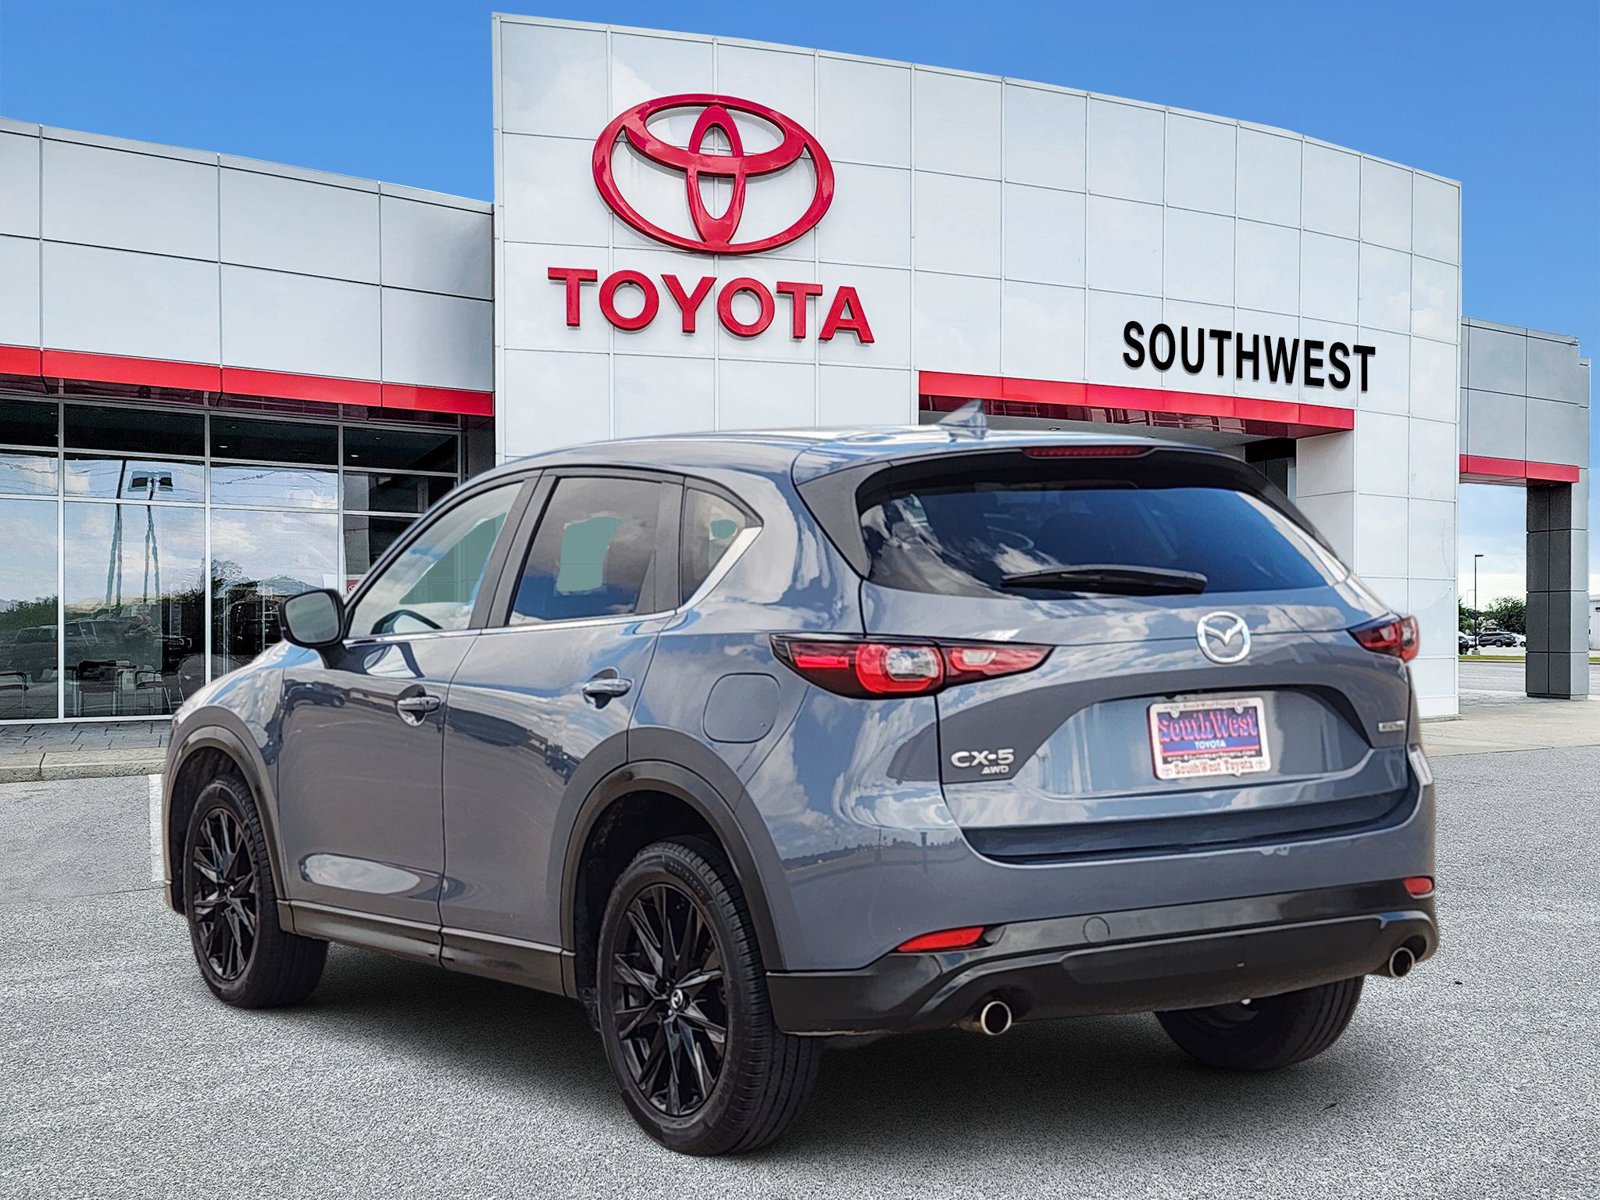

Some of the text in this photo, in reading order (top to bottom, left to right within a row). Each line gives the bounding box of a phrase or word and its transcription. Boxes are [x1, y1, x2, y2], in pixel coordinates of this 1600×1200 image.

[548, 267, 875, 343] TOYOTA
[1123, 320, 1376, 392] SOUTHWEST
[1158, 710, 1257, 742] SouthWest
[1194, 740, 1227, 749] TOYOTA
[951, 748, 1014, 767] CX-5
[1223, 759, 1254, 773] Toyota
[981, 765, 1009, 775] AWD
